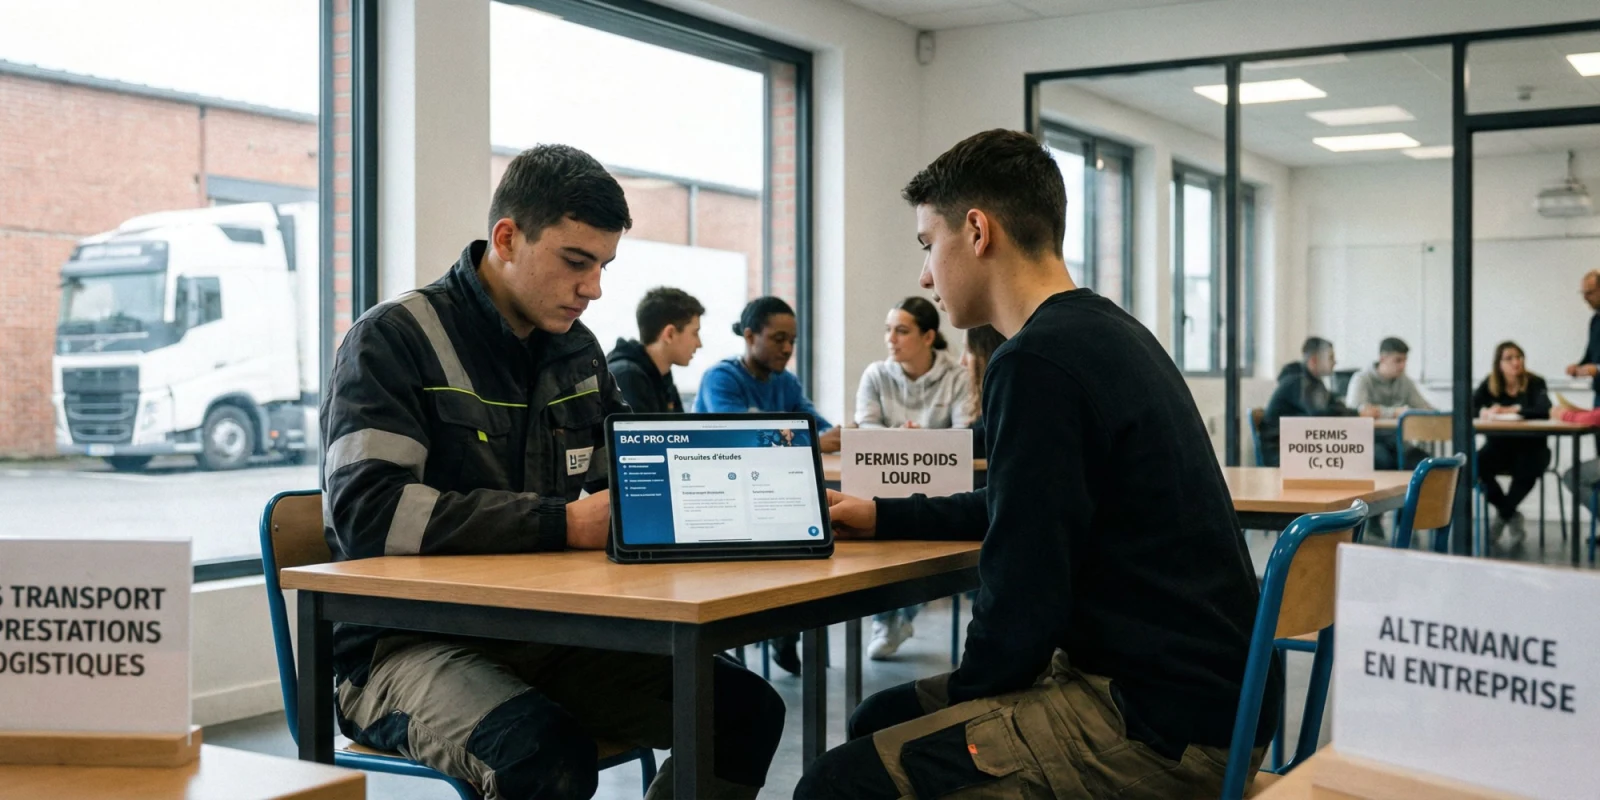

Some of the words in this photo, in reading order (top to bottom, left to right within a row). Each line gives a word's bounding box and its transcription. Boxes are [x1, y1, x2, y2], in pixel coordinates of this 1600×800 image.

[620, 435, 641, 444] BAC
[643, 434, 665, 444] PRO
[666, 434, 690, 443] CRM
[1305, 430, 1348, 440] PERMIS
[1288, 443, 1323, 454] POIDS
[1325, 443, 1365, 454] LOURD
[673, 453, 711, 461] Poursuites
[712, 453, 742, 461] d'études
[855, 452, 909, 466] PERMIS
[913, 453, 958, 466] POIDS
[1308, 456, 1323, 469] (C,
[1325, 456, 1344, 470] CE)
[881, 471, 931, 485] LOURD
[10, 585, 166, 610] TRANSPORT
[0, 618, 162, 644] RESTATIONS
[1378, 615, 1558, 668] ALTERNANCE
[1364, 650, 1396, 680] EN
[1404, 656, 1577, 713] ENTREPRISE
